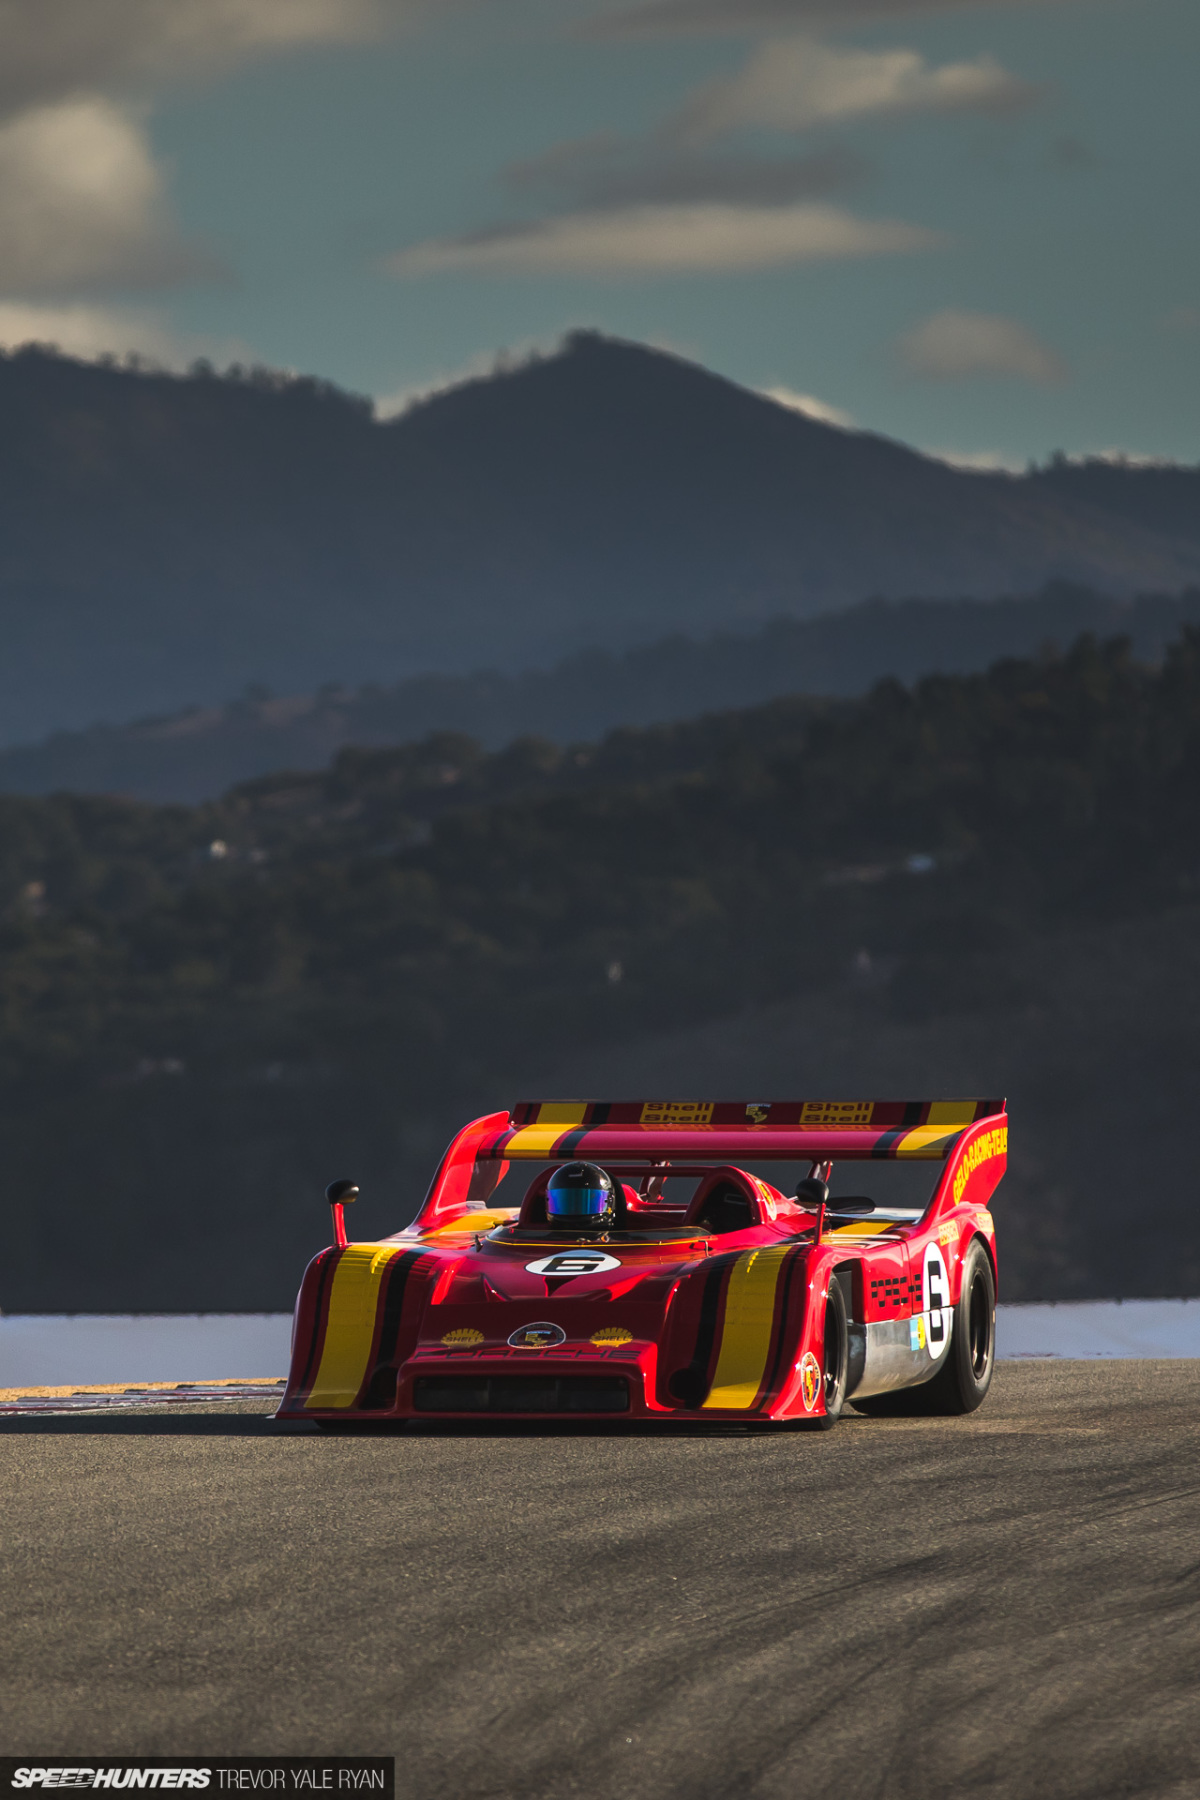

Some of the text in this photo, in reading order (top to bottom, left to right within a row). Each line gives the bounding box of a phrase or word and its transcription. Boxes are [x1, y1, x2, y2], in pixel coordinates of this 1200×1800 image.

[645, 1102, 711, 1111] Shell
[805, 1102, 871, 1111] Shell
[642, 1113, 708, 1121] Shell
[802, 1113, 868, 1122] Shell
[542, 1257, 605, 1272] 6
[928, 1260, 944, 1342] 6
[413, 1349, 641, 1360] PORSCHE
